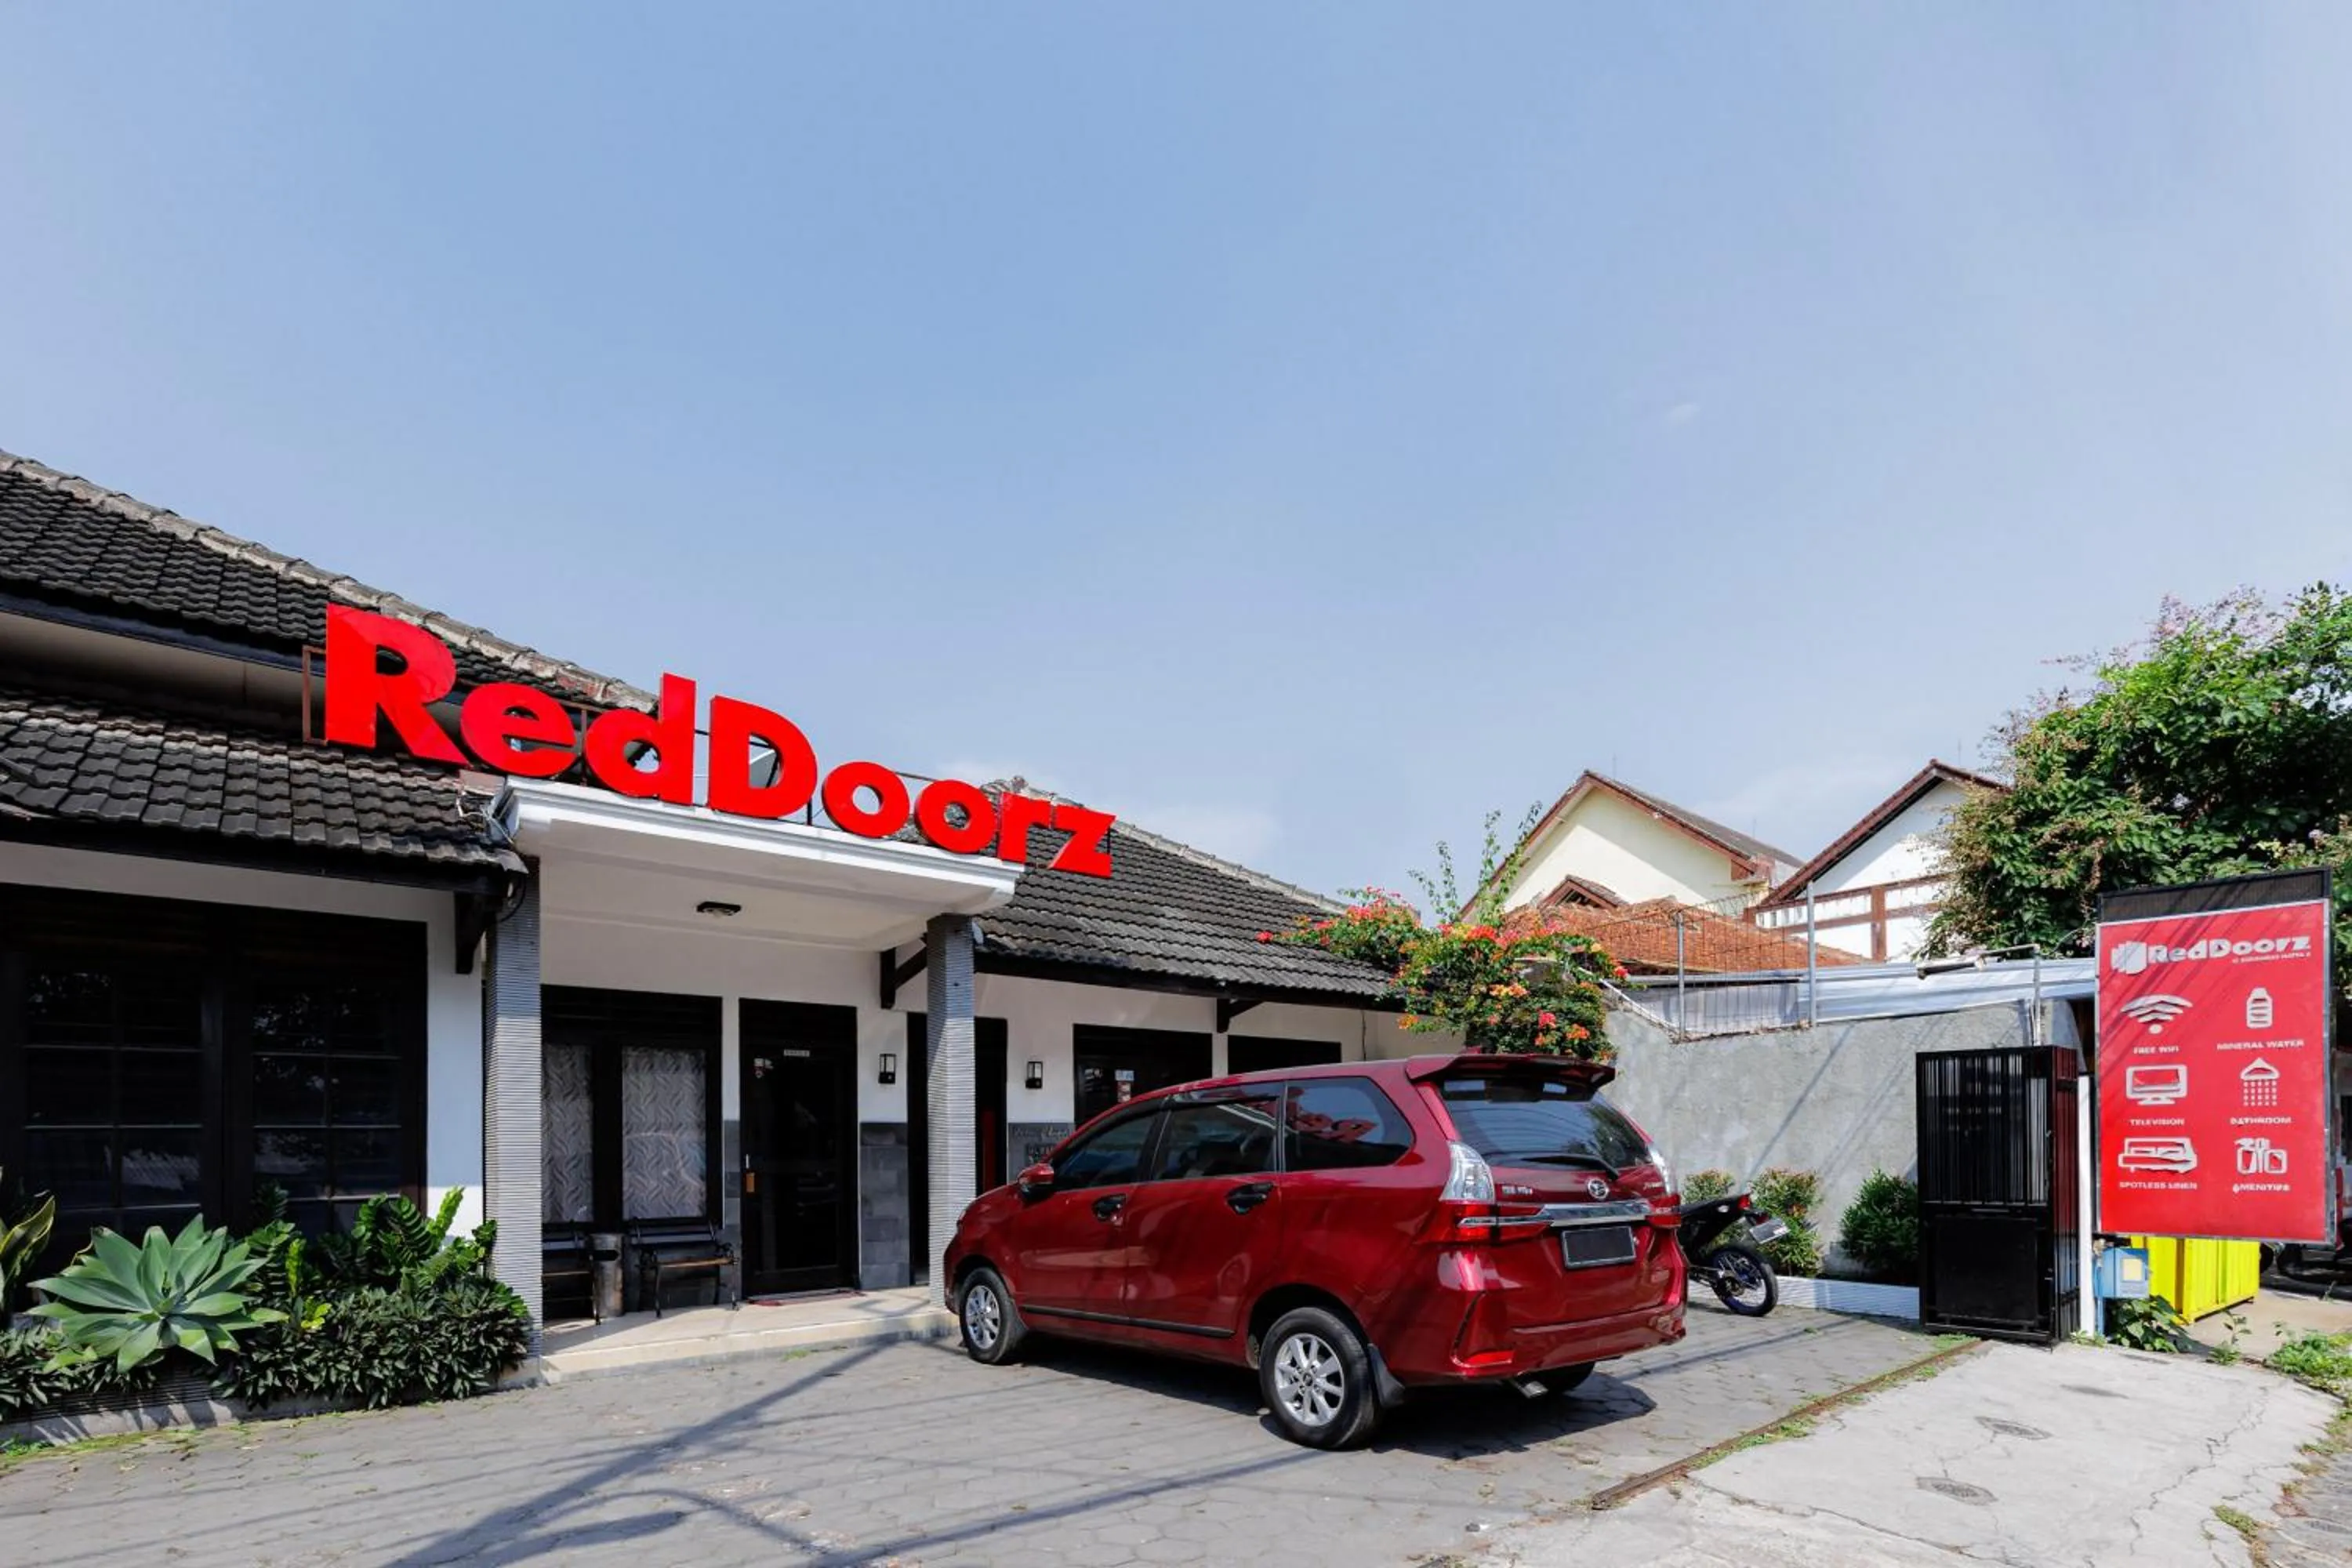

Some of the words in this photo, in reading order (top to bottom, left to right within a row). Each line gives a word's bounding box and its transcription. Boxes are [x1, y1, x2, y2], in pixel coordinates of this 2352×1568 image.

[325, 604, 1116, 877] RedDoorz
[2148, 936, 2311, 964] RedDoorz
[2133, 1046, 2155, 1054] FREE
[2216, 1041, 2264, 1051] MINERAL
[2267, 1039, 2305, 1049] WATER
[2230, 1116, 2292, 1126] BATHROOM
